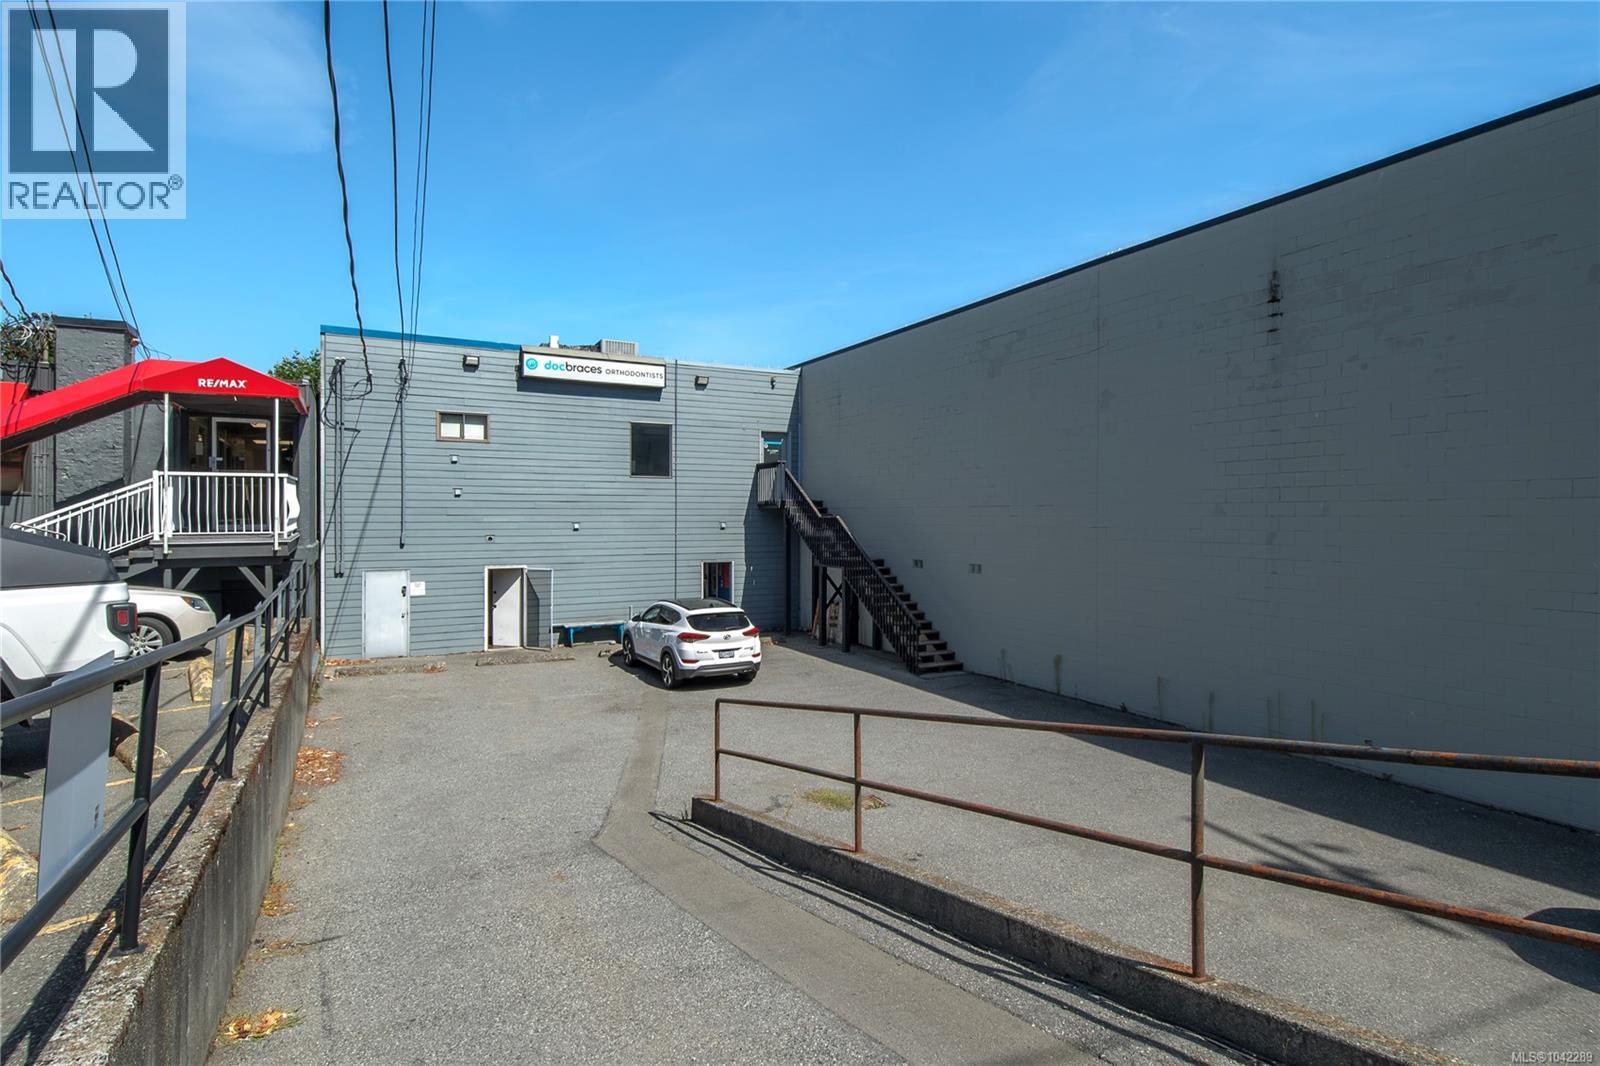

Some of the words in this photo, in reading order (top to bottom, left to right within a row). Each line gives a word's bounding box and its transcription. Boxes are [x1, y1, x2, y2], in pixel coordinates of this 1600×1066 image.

[544, 360, 602, 374] docbraces
[605, 368, 663, 379] ORTHODONTISTS
[197, 378, 247, 389] RE/MAX
